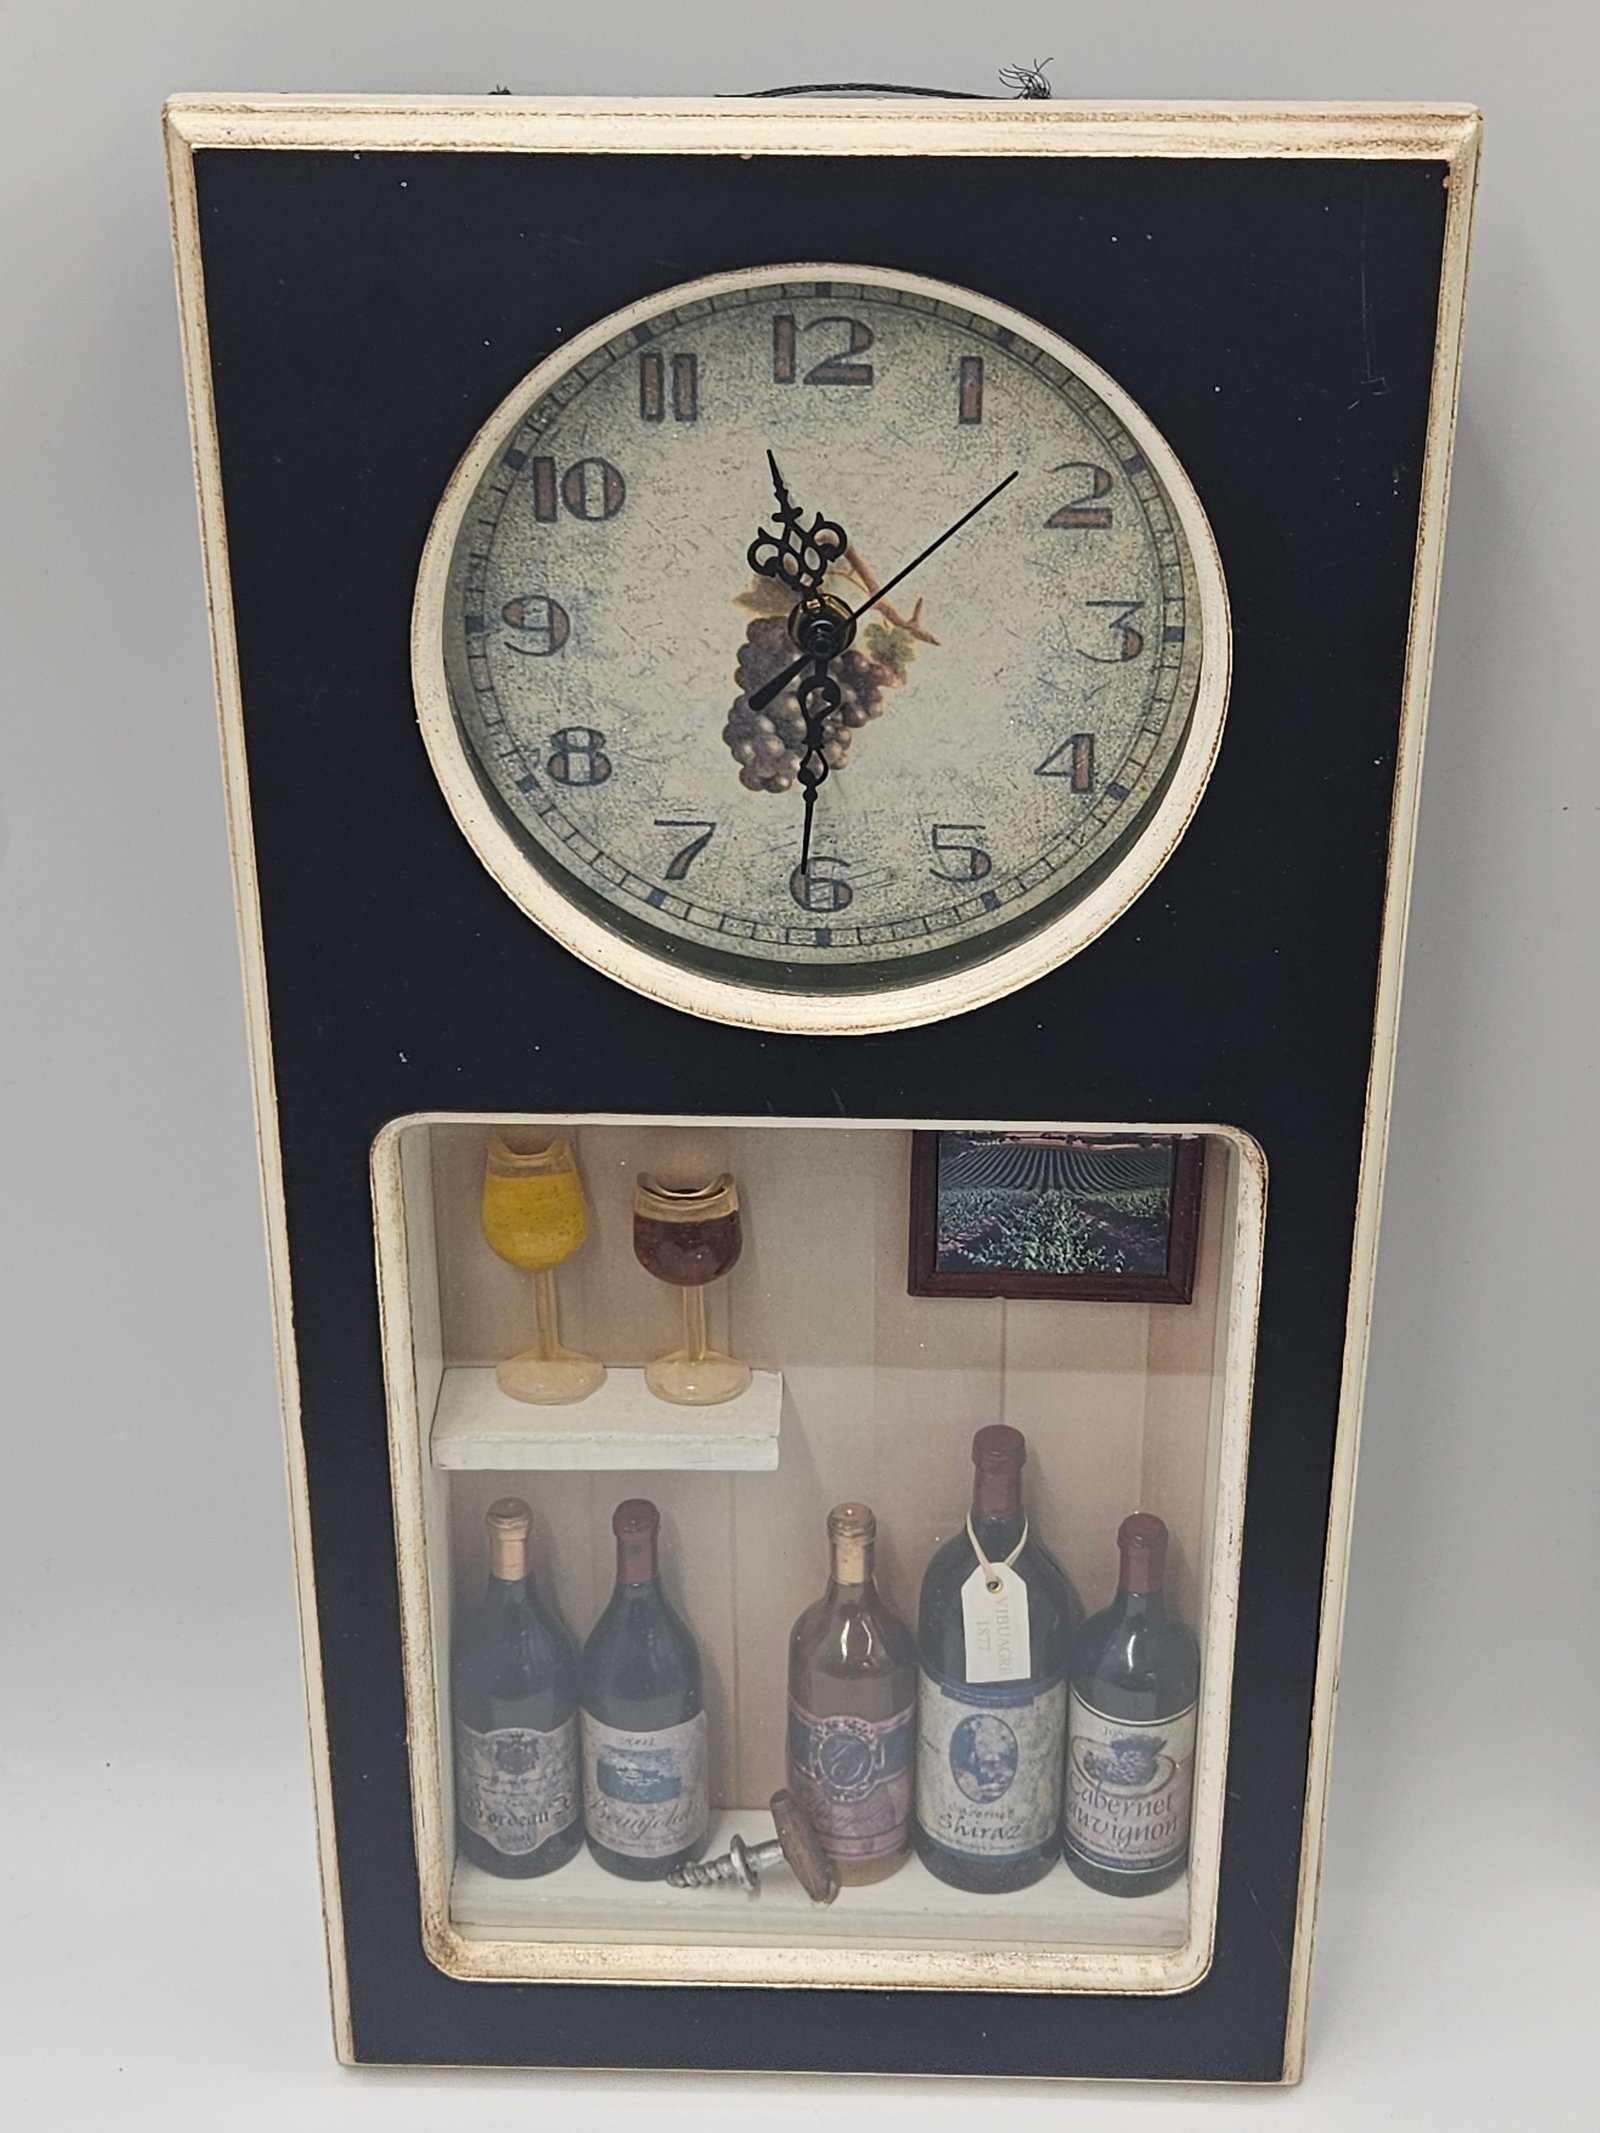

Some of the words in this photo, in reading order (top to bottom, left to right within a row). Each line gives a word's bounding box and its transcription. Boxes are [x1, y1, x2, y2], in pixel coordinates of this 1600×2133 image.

[772, 314, 875, 386] 12
[640, 351, 698, 422] 11
[958, 355, 984, 425] 1
[531, 455, 628, 524] 10
[1042, 461, 1114, 529] 2
[500, 594, 572, 657] 9
[1075, 600, 1145, 664] 3
[546, 725, 613, 788] 8
[1032, 732, 1096, 794] 4
[653, 818, 717, 881] 7
[929, 823, 993, 883] 5
[790, 855, 854, 914] 6
[976, 1620, 991, 1652] 1877
[1069, 1769, 1173, 1818] Cabernet
[938, 1812, 1022, 1841] Shiraz
